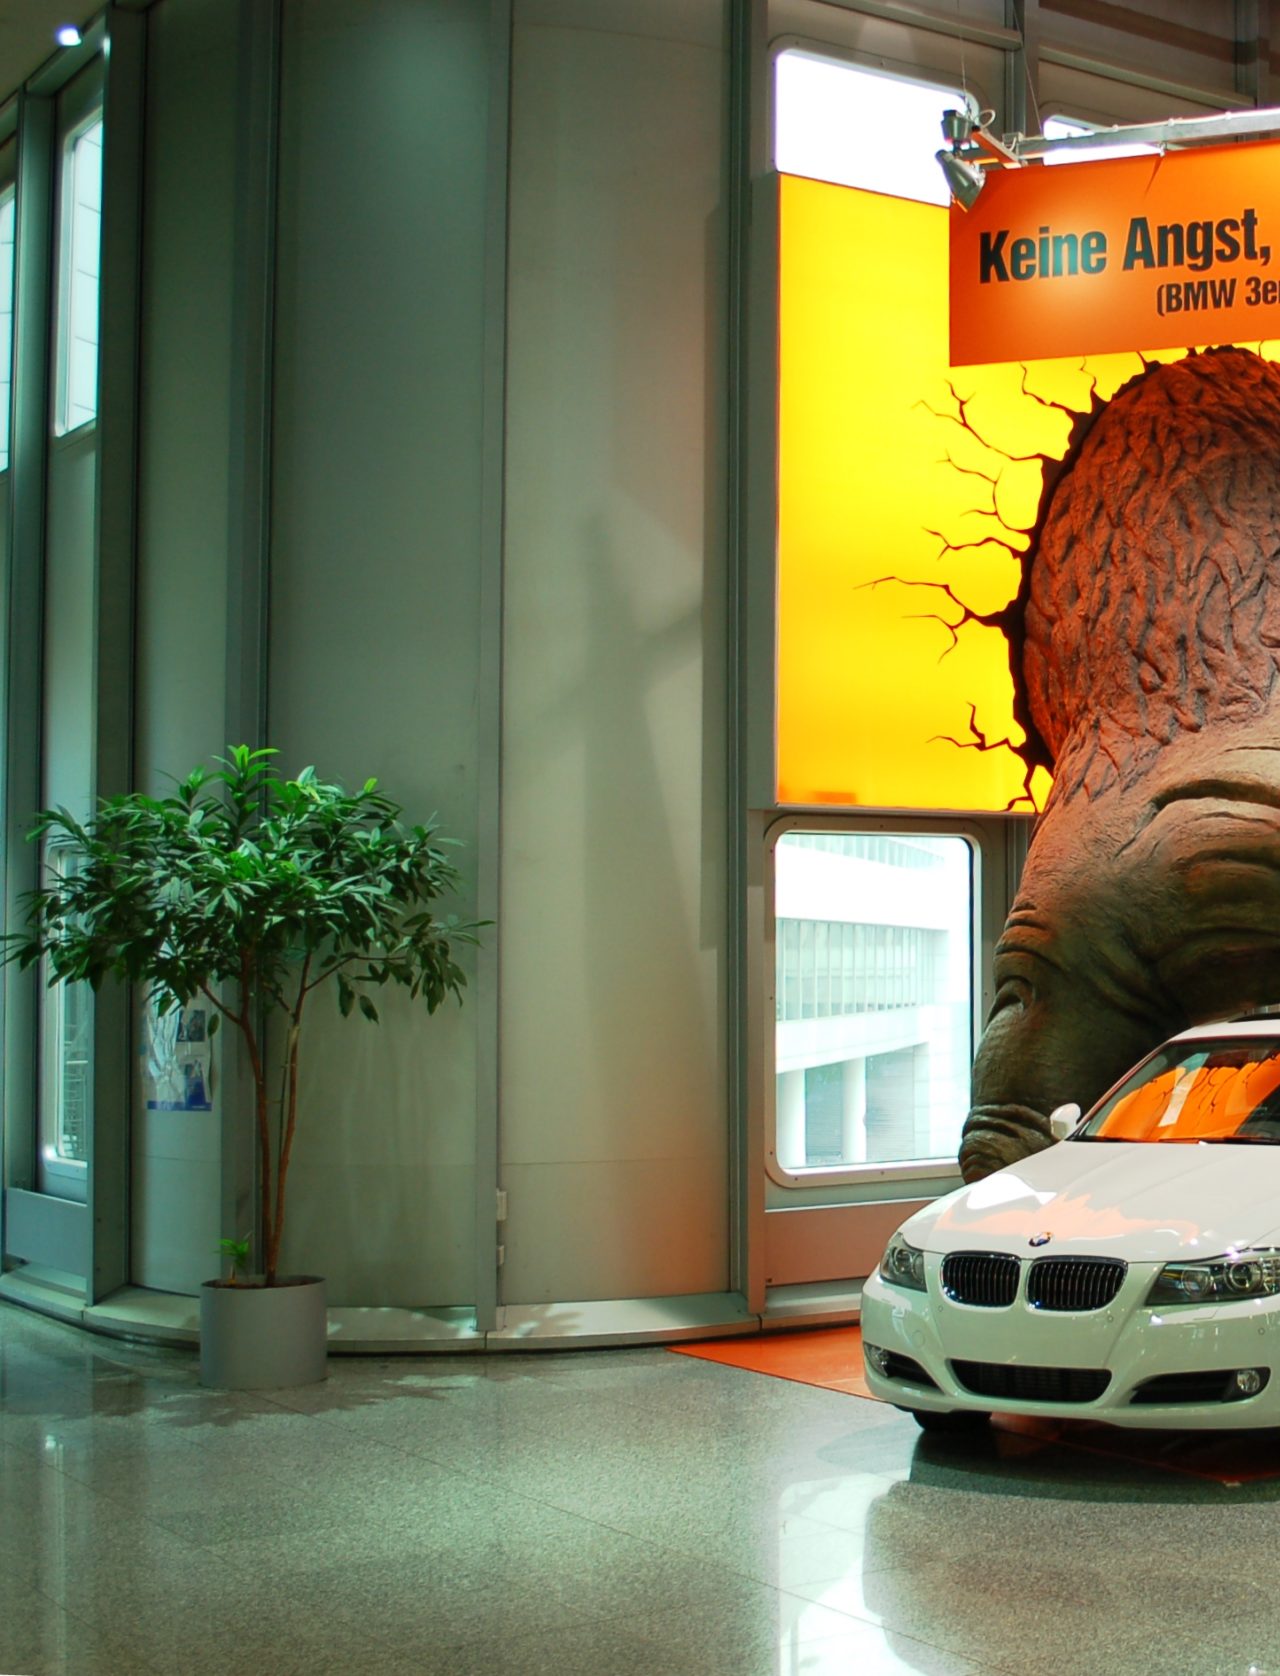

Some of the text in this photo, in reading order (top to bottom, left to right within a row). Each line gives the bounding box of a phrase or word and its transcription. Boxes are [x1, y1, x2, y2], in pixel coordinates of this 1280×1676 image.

[979, 227, 1107, 284] Keine
[1123, 209, 1271, 271] Angst,
[1157, 278, 1237, 316] (BMW
